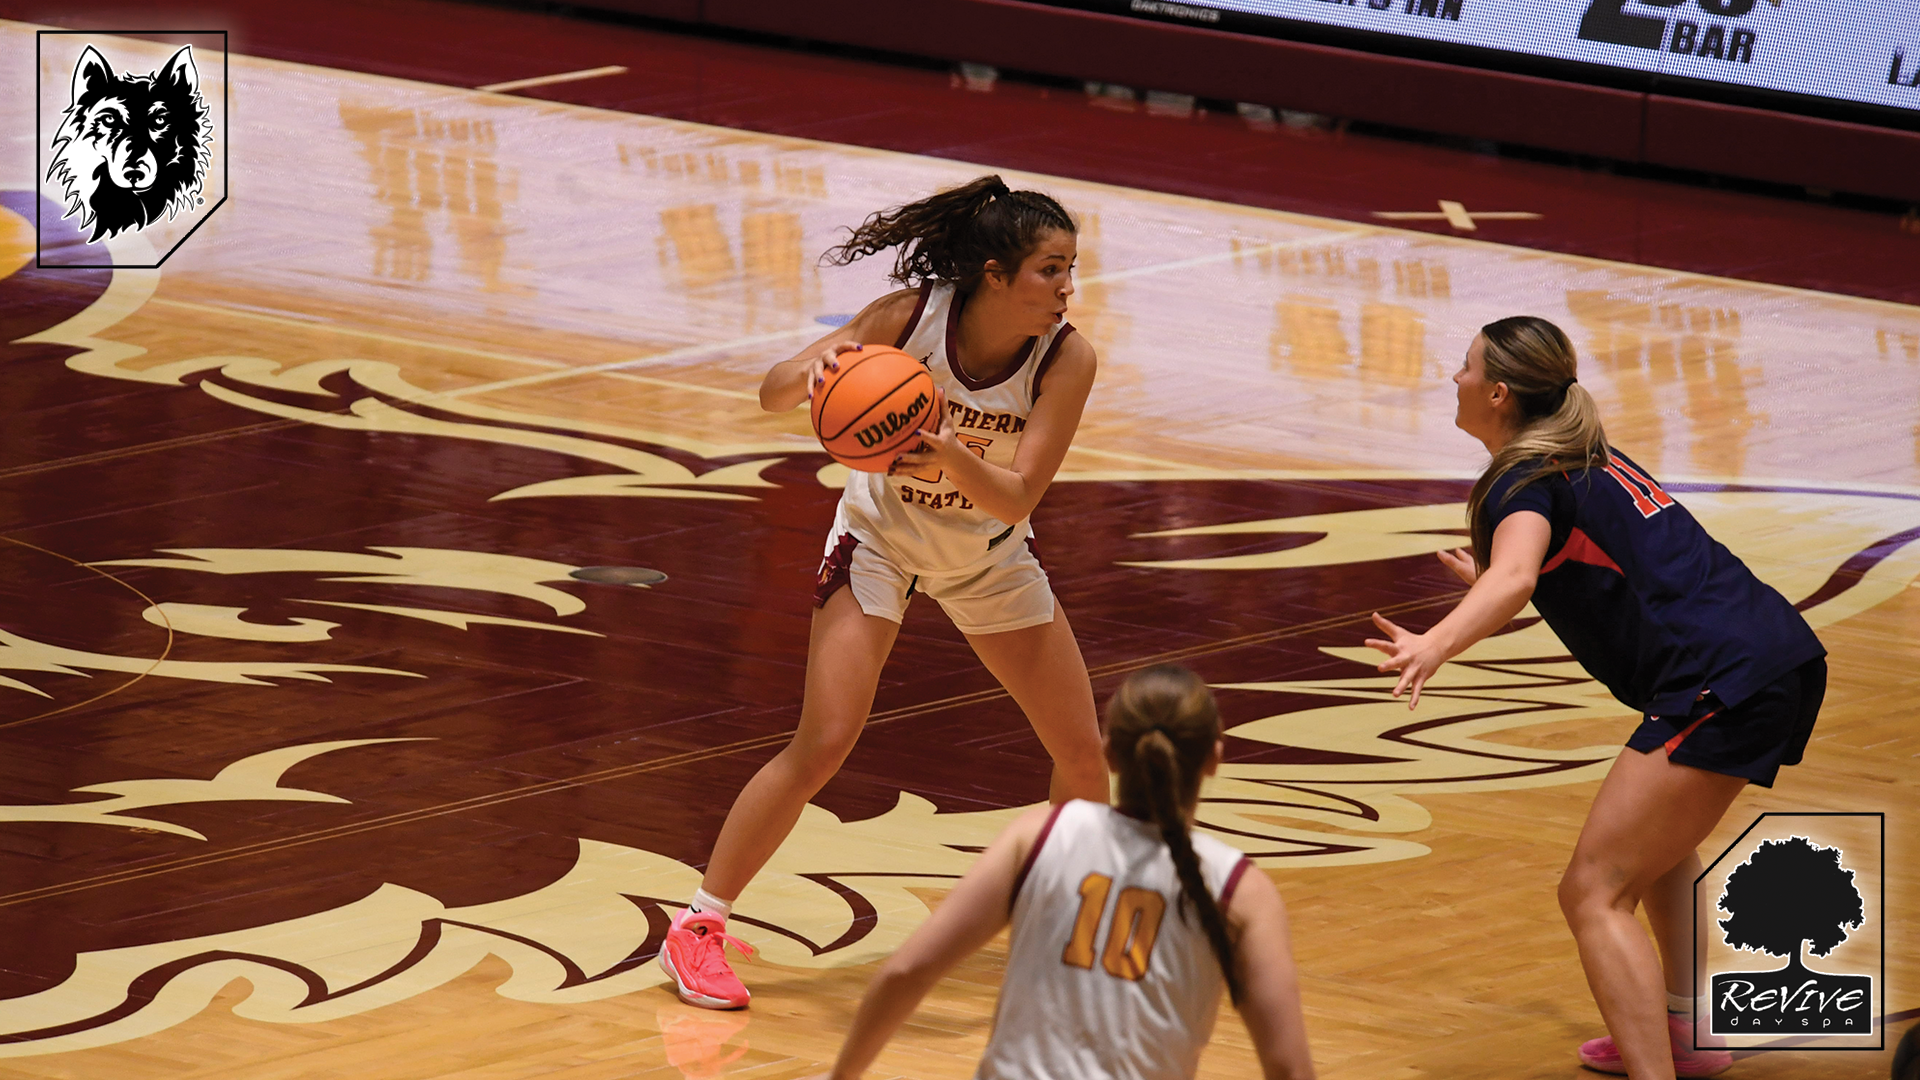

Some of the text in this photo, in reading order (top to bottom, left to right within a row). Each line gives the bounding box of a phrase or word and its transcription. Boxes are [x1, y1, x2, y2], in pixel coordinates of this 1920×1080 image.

[1669, 21, 1755, 64] BAR
[853, 391, 929, 448] Wilson
[1601, 452, 1675, 519] 11
[1061, 871, 1167, 982] 10
